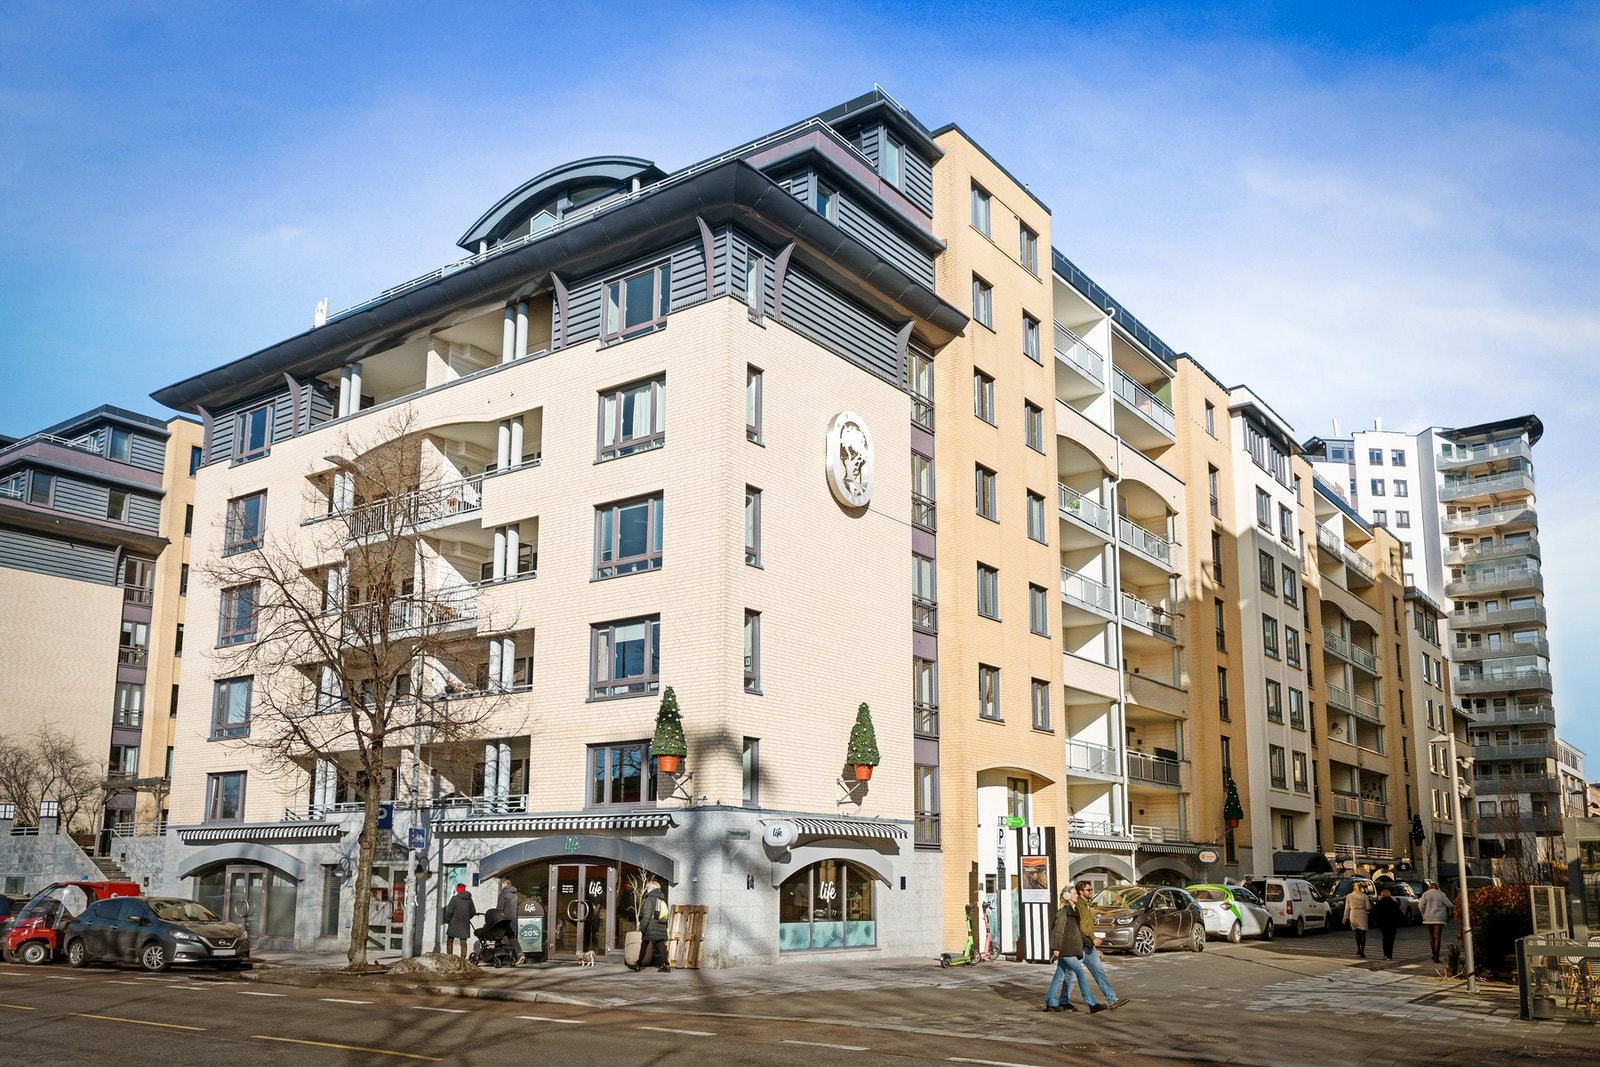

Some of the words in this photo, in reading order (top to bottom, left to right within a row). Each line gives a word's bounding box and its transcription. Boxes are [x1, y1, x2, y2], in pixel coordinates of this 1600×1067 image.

[377, 807, 388, 826] P
[772, 827, 783, 839] life
[999, 828, 1004, 845] P
[588, 881, 604, 897] life
[820, 880, 837, 903] life
[524, 903, 536, 913] life
